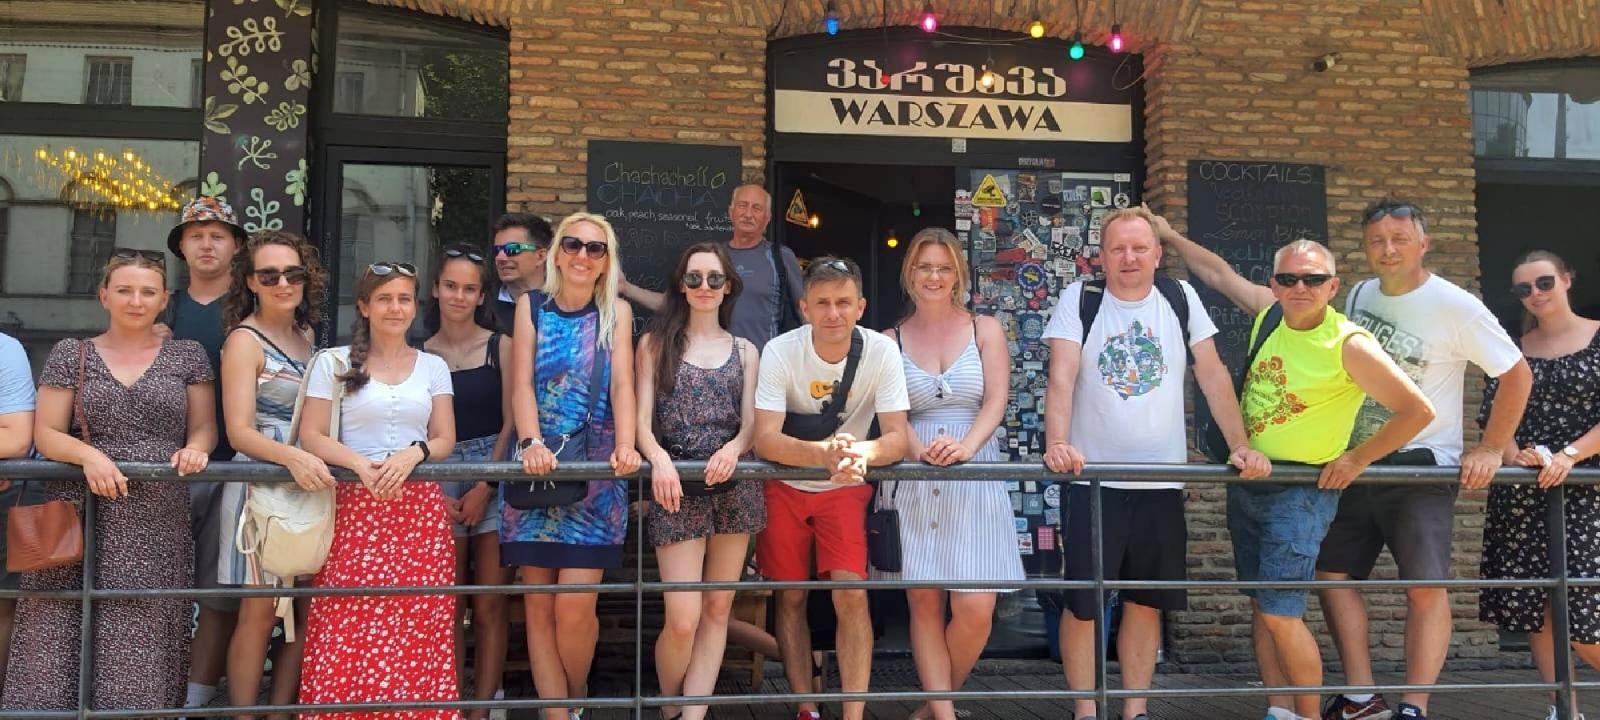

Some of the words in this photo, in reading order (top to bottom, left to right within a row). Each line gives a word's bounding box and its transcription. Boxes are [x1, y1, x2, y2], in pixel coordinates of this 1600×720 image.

[830, 97, 1062, 133] WARSZAWA
[1200, 161, 1312, 184] COCKTAILS
[596, 183, 719, 209] CHACHA
